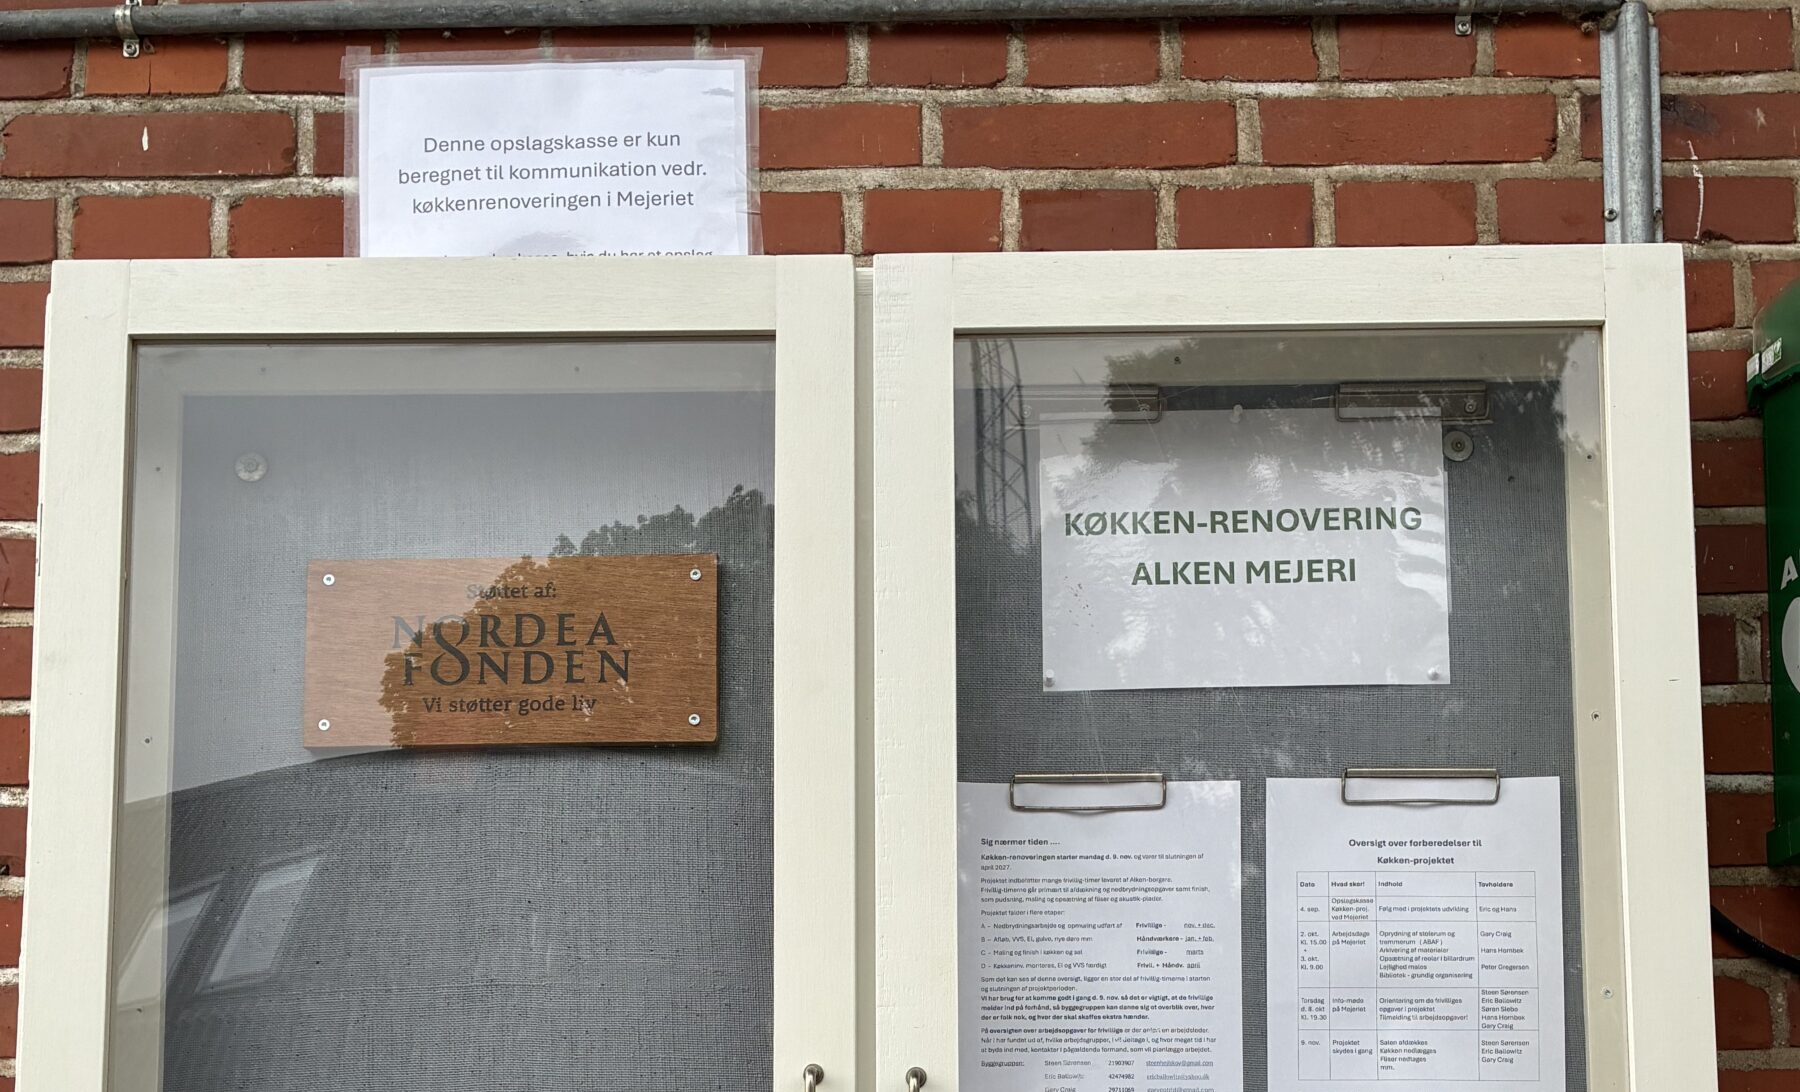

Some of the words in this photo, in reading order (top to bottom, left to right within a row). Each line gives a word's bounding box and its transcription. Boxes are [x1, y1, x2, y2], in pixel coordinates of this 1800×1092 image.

[423, 136, 485, 153] Denne
[490, 134, 618, 155] opslagskasse
[623, 134, 642, 147] er
[646, 130, 680, 147] kun
[398, 166, 481, 186] beregnet
[485, 164, 504, 180] til
[509, 160, 656, 180] kommunikation
[661, 160, 706, 176] vedr.
[412, 194, 601, 213] køkkenrenoveringen
[617, 189, 694, 210] Mejeriet
[1064, 506, 1422, 536] KØKKEN-RENOVERING
[1131, 560, 1235, 586] ALKEN
[1246, 558, 1356, 584] MEJERI
[467, 583, 528, 600] Støttet
[534, 582, 557, 598] af:
[391, 611, 619, 648] NORDEA
[402, 649, 632, 686] FONDEN
[421, 696, 443, 712] Vi
[448, 697, 512, 712] støtter
[518, 695, 566, 716] gode
[572, 694, 598, 712] liv
[1348, 838, 1386, 848] Oversigt
[1408, 839, 1471, 847] forberedelser
[1376, 856, 1454, 865] Køkken-projektet
